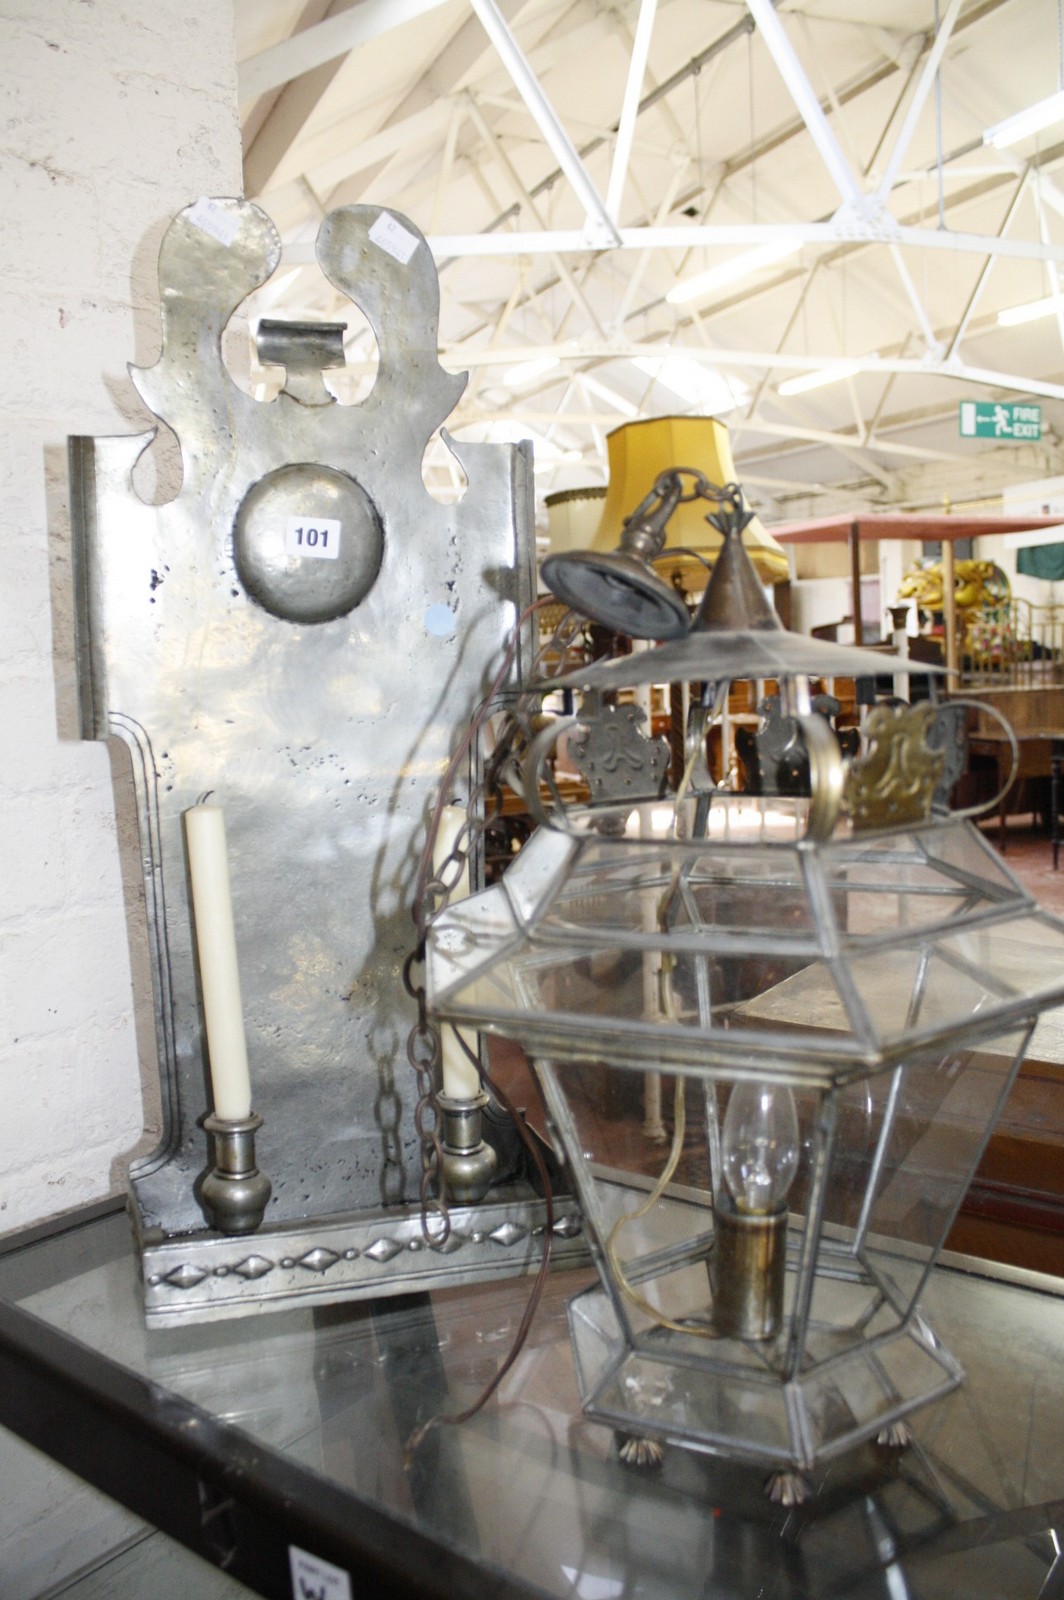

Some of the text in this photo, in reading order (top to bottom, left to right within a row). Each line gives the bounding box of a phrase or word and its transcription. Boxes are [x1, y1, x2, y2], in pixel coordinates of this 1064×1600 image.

[1012, 406, 1040, 422] FIRE
[1012, 422, 1039, 438] EXIT
[294, 527, 329, 548] 101
